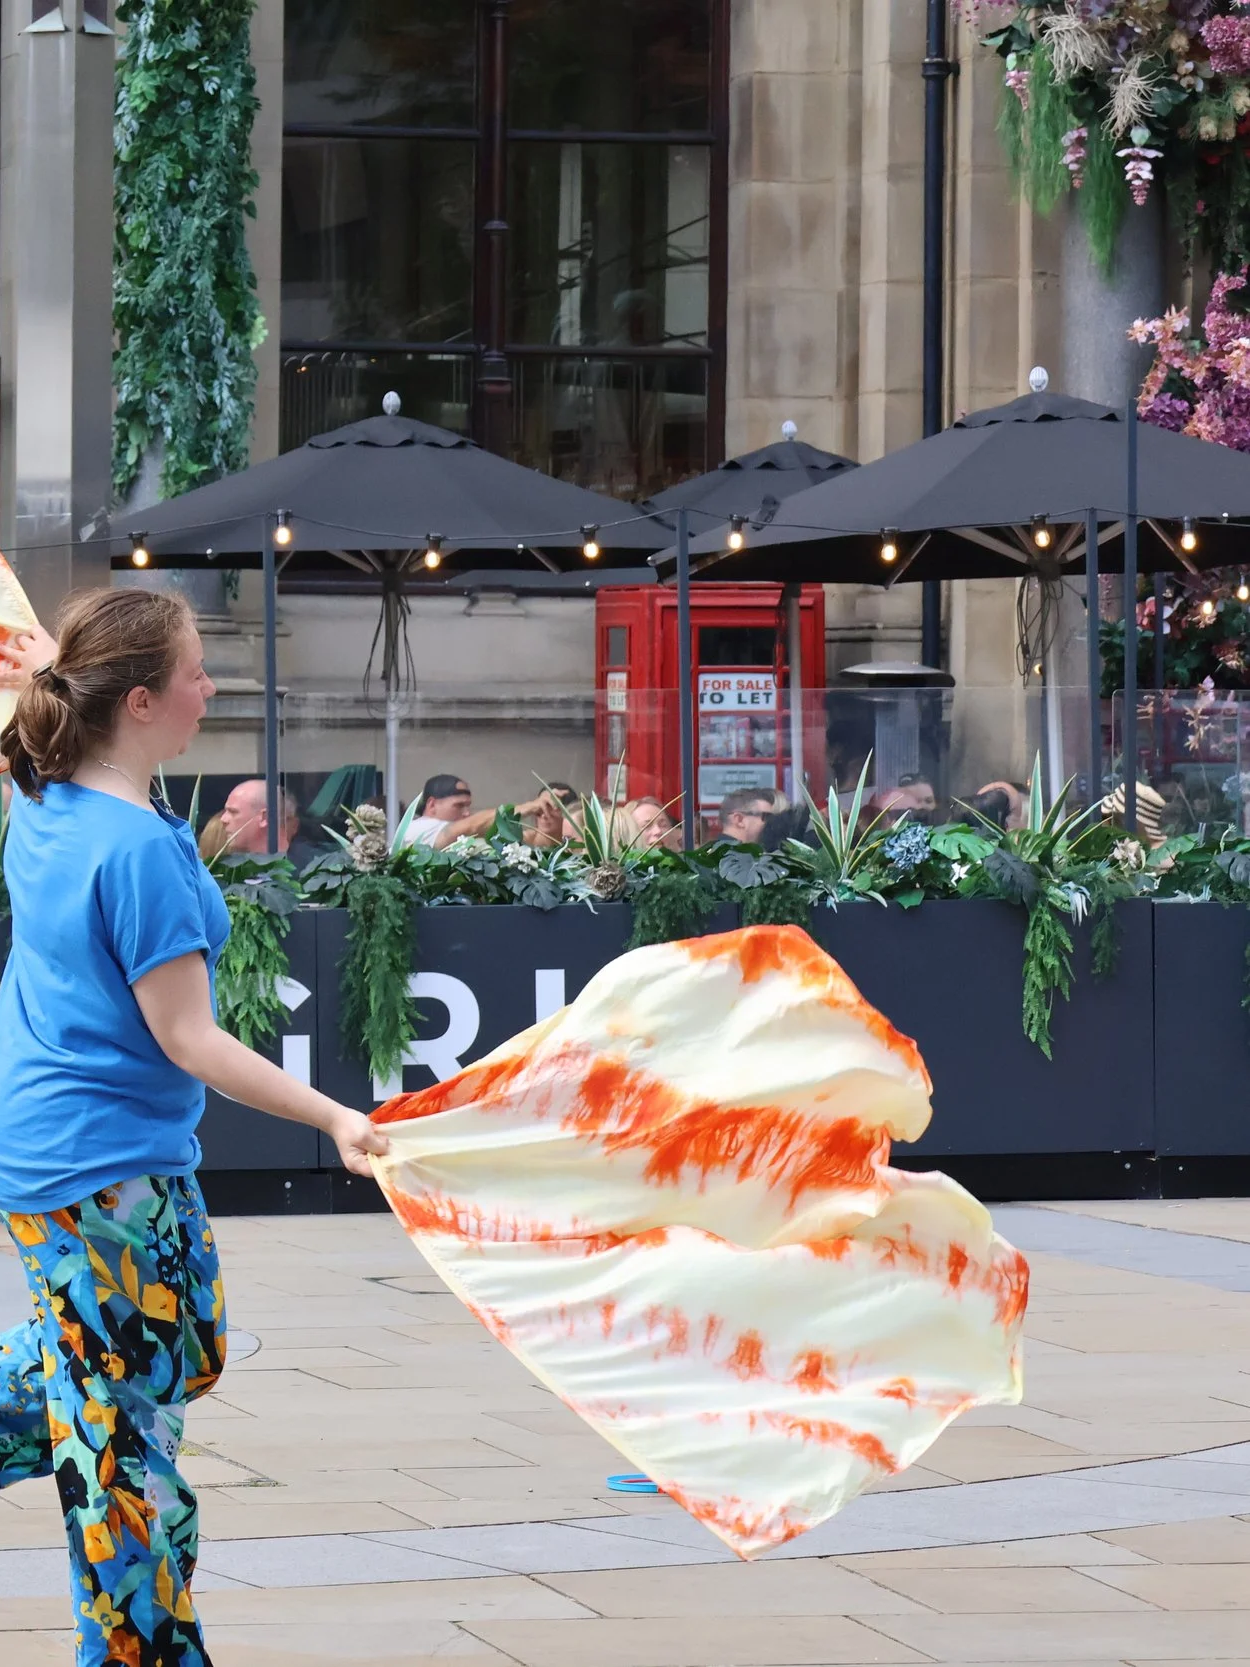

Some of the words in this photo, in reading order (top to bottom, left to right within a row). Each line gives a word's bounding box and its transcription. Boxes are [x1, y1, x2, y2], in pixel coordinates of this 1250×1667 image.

[702, 679, 732, 690] FOR
[736, 679, 773, 690] SALE
[699, 692, 725, 705] TO
[737, 692, 773, 705] LET
